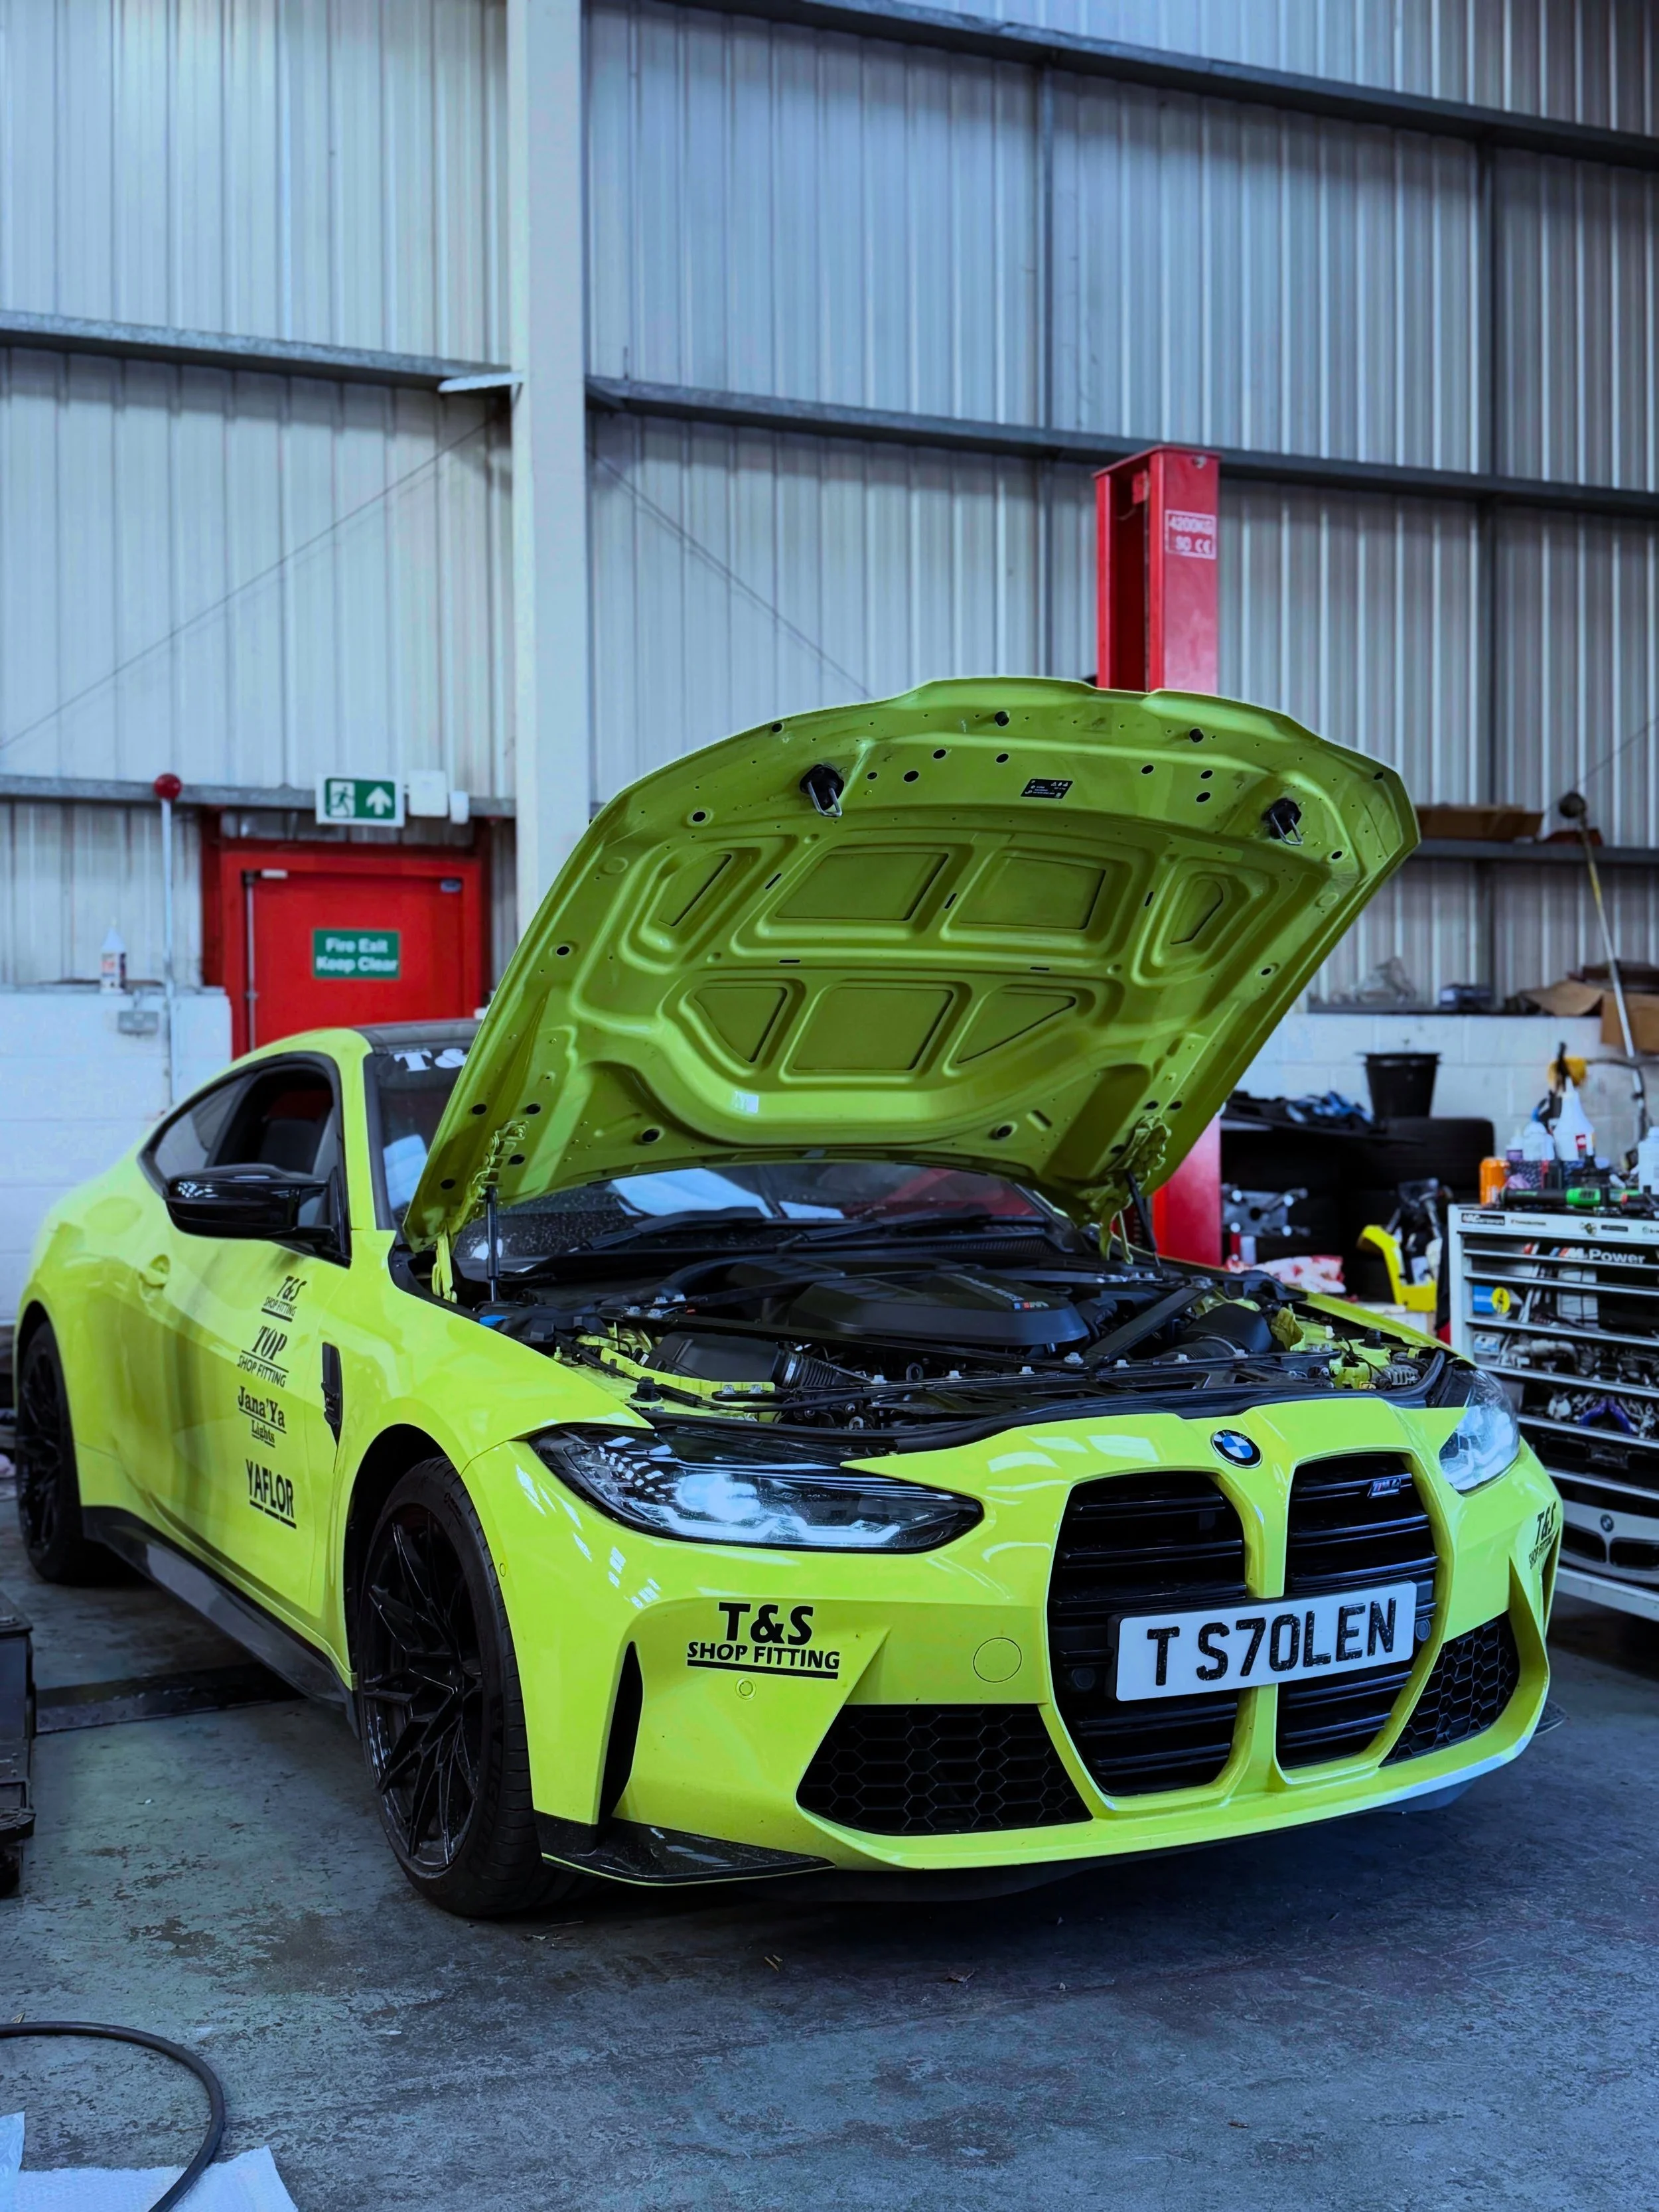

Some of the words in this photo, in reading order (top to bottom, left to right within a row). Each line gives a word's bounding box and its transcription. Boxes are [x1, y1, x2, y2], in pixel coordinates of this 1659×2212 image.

[325, 936, 356, 953] Fire
[358, 938, 388, 954] Exit
[316, 955, 356, 974] Keep
[358, 956, 397, 972] Clear
[1589, 1248, 1645, 1264] Power
[277, 1276, 307, 1302] T&S
[263, 1296, 279, 1310] SHOP
[277, 1300, 297, 1317] FITTING
[252, 1326, 287, 1361] TOP
[237, 1355, 257, 1374] SHOP
[257, 1364, 287, 1388] FITTING
[252, 1420, 275, 1443] Lights
[246, 1459, 294, 1518] YAFLOR
[1535, 1501, 1557, 1546] T&S
[719, 1601, 814, 1646] T&S
[687, 1641, 748, 1661] SHOP
[754, 1645, 840, 1669] FITTING
